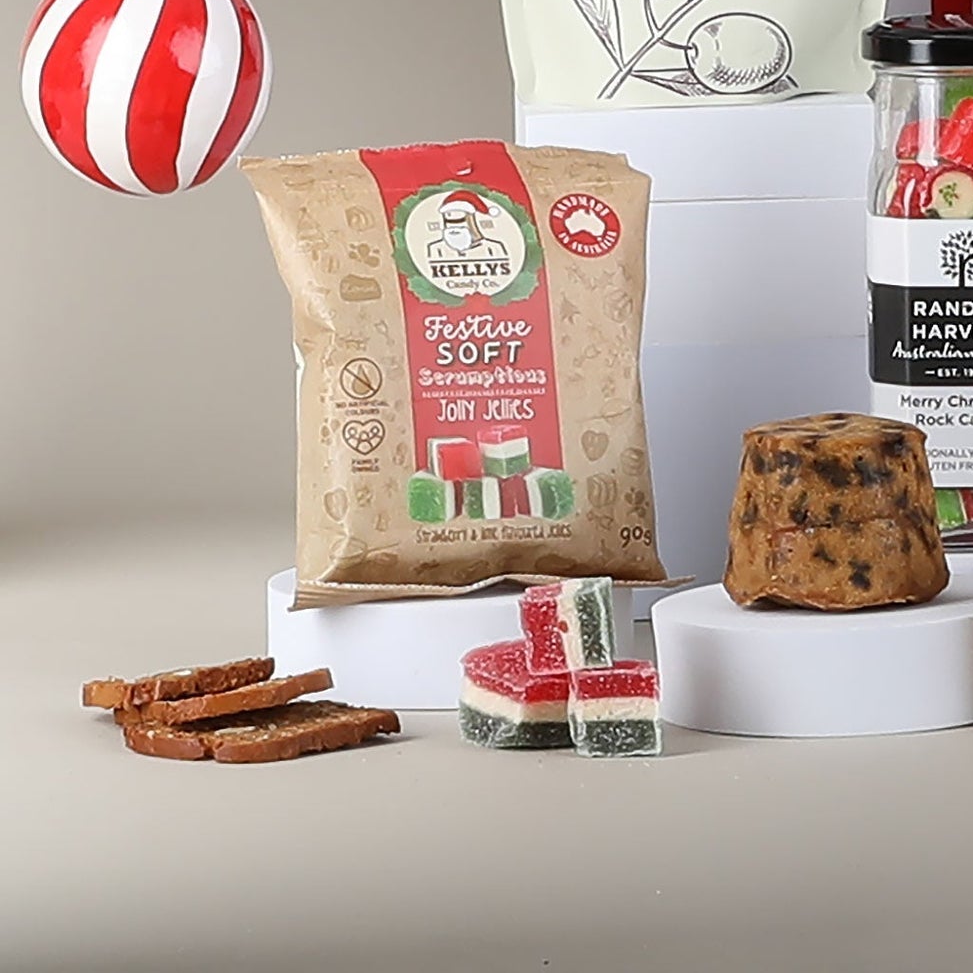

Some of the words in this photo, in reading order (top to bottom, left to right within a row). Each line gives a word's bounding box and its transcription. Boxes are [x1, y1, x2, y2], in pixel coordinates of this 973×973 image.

[431, 262, 511, 278] KELLYS
[446, 279, 480, 291] Candy
[424, 314, 532, 342] Festive
[436, 340, 522, 365] SOFT
[900, 394, 943, 410] Merry
[915, 413, 954, 427] Rock
